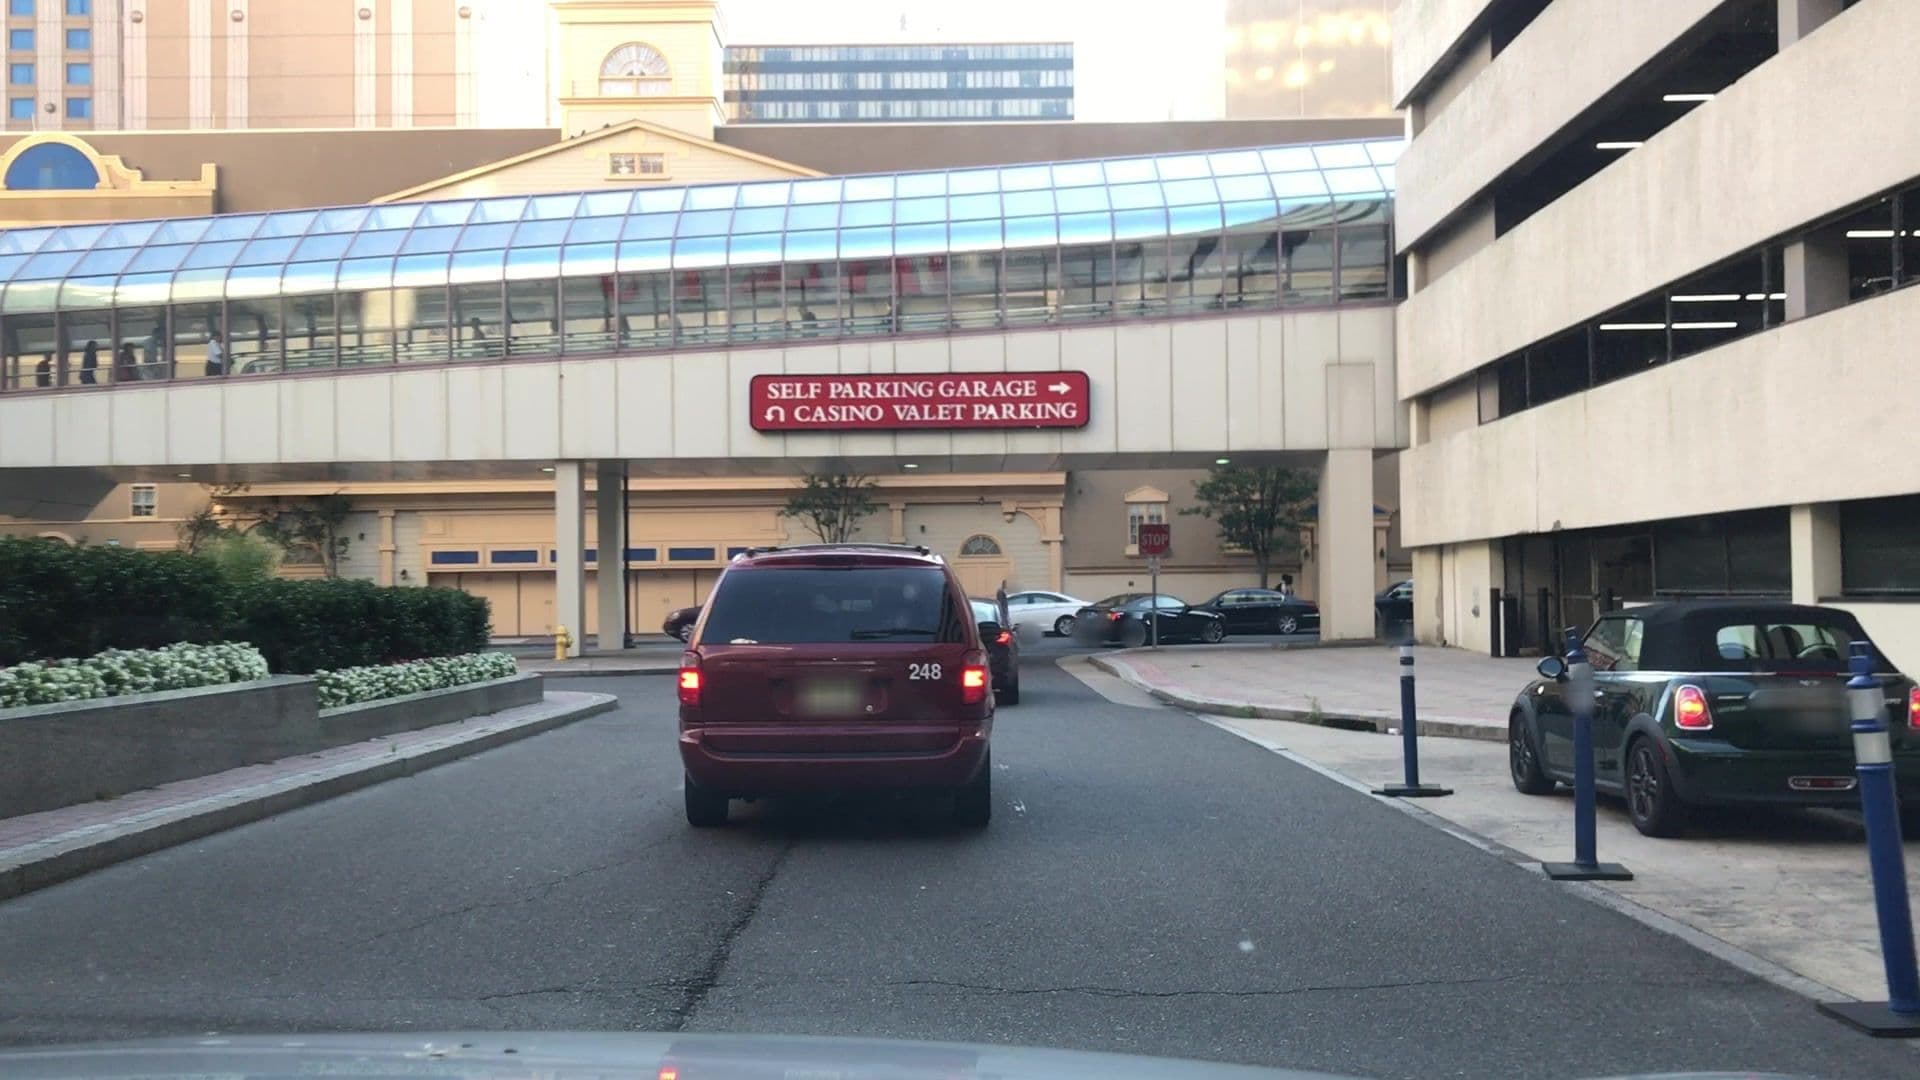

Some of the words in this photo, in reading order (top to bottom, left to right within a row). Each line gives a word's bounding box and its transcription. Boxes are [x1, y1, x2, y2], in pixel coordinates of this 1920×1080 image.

[767, 382, 822, 399] SELF
[828, 381, 934, 399] PARKING
[938, 380, 1037, 397] GARAGE
[793, 404, 884, 422] CASINO
[892, 403, 967, 421] VALET
[973, 402, 1077, 420] PARKING
[1141, 533, 1169, 546] STOP
[909, 663, 942, 680] 248
